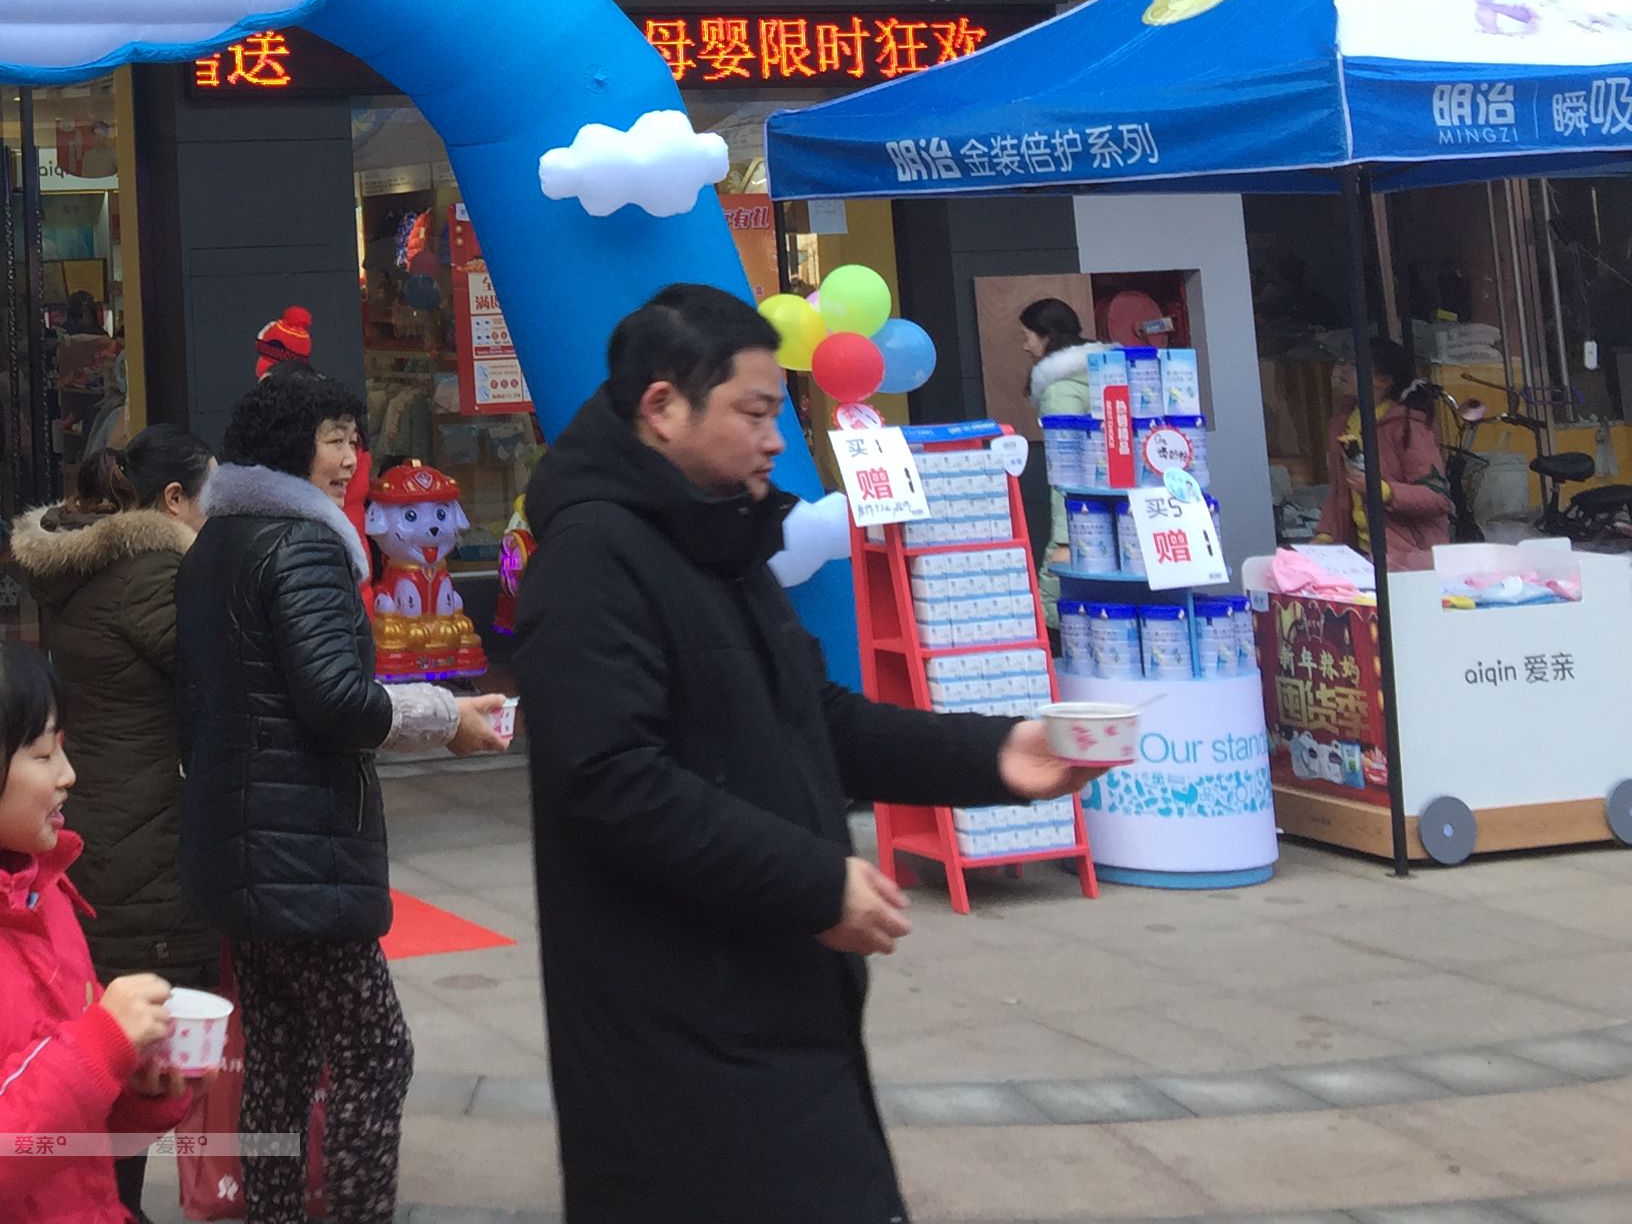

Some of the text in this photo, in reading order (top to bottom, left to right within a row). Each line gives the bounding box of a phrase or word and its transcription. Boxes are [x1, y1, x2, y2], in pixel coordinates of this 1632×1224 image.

[645, 17, 988, 81] 母婴限时狂欢
[1463, 653, 1576, 688] aiqin 爱亲
[1139, 731, 1203, 765] Our
